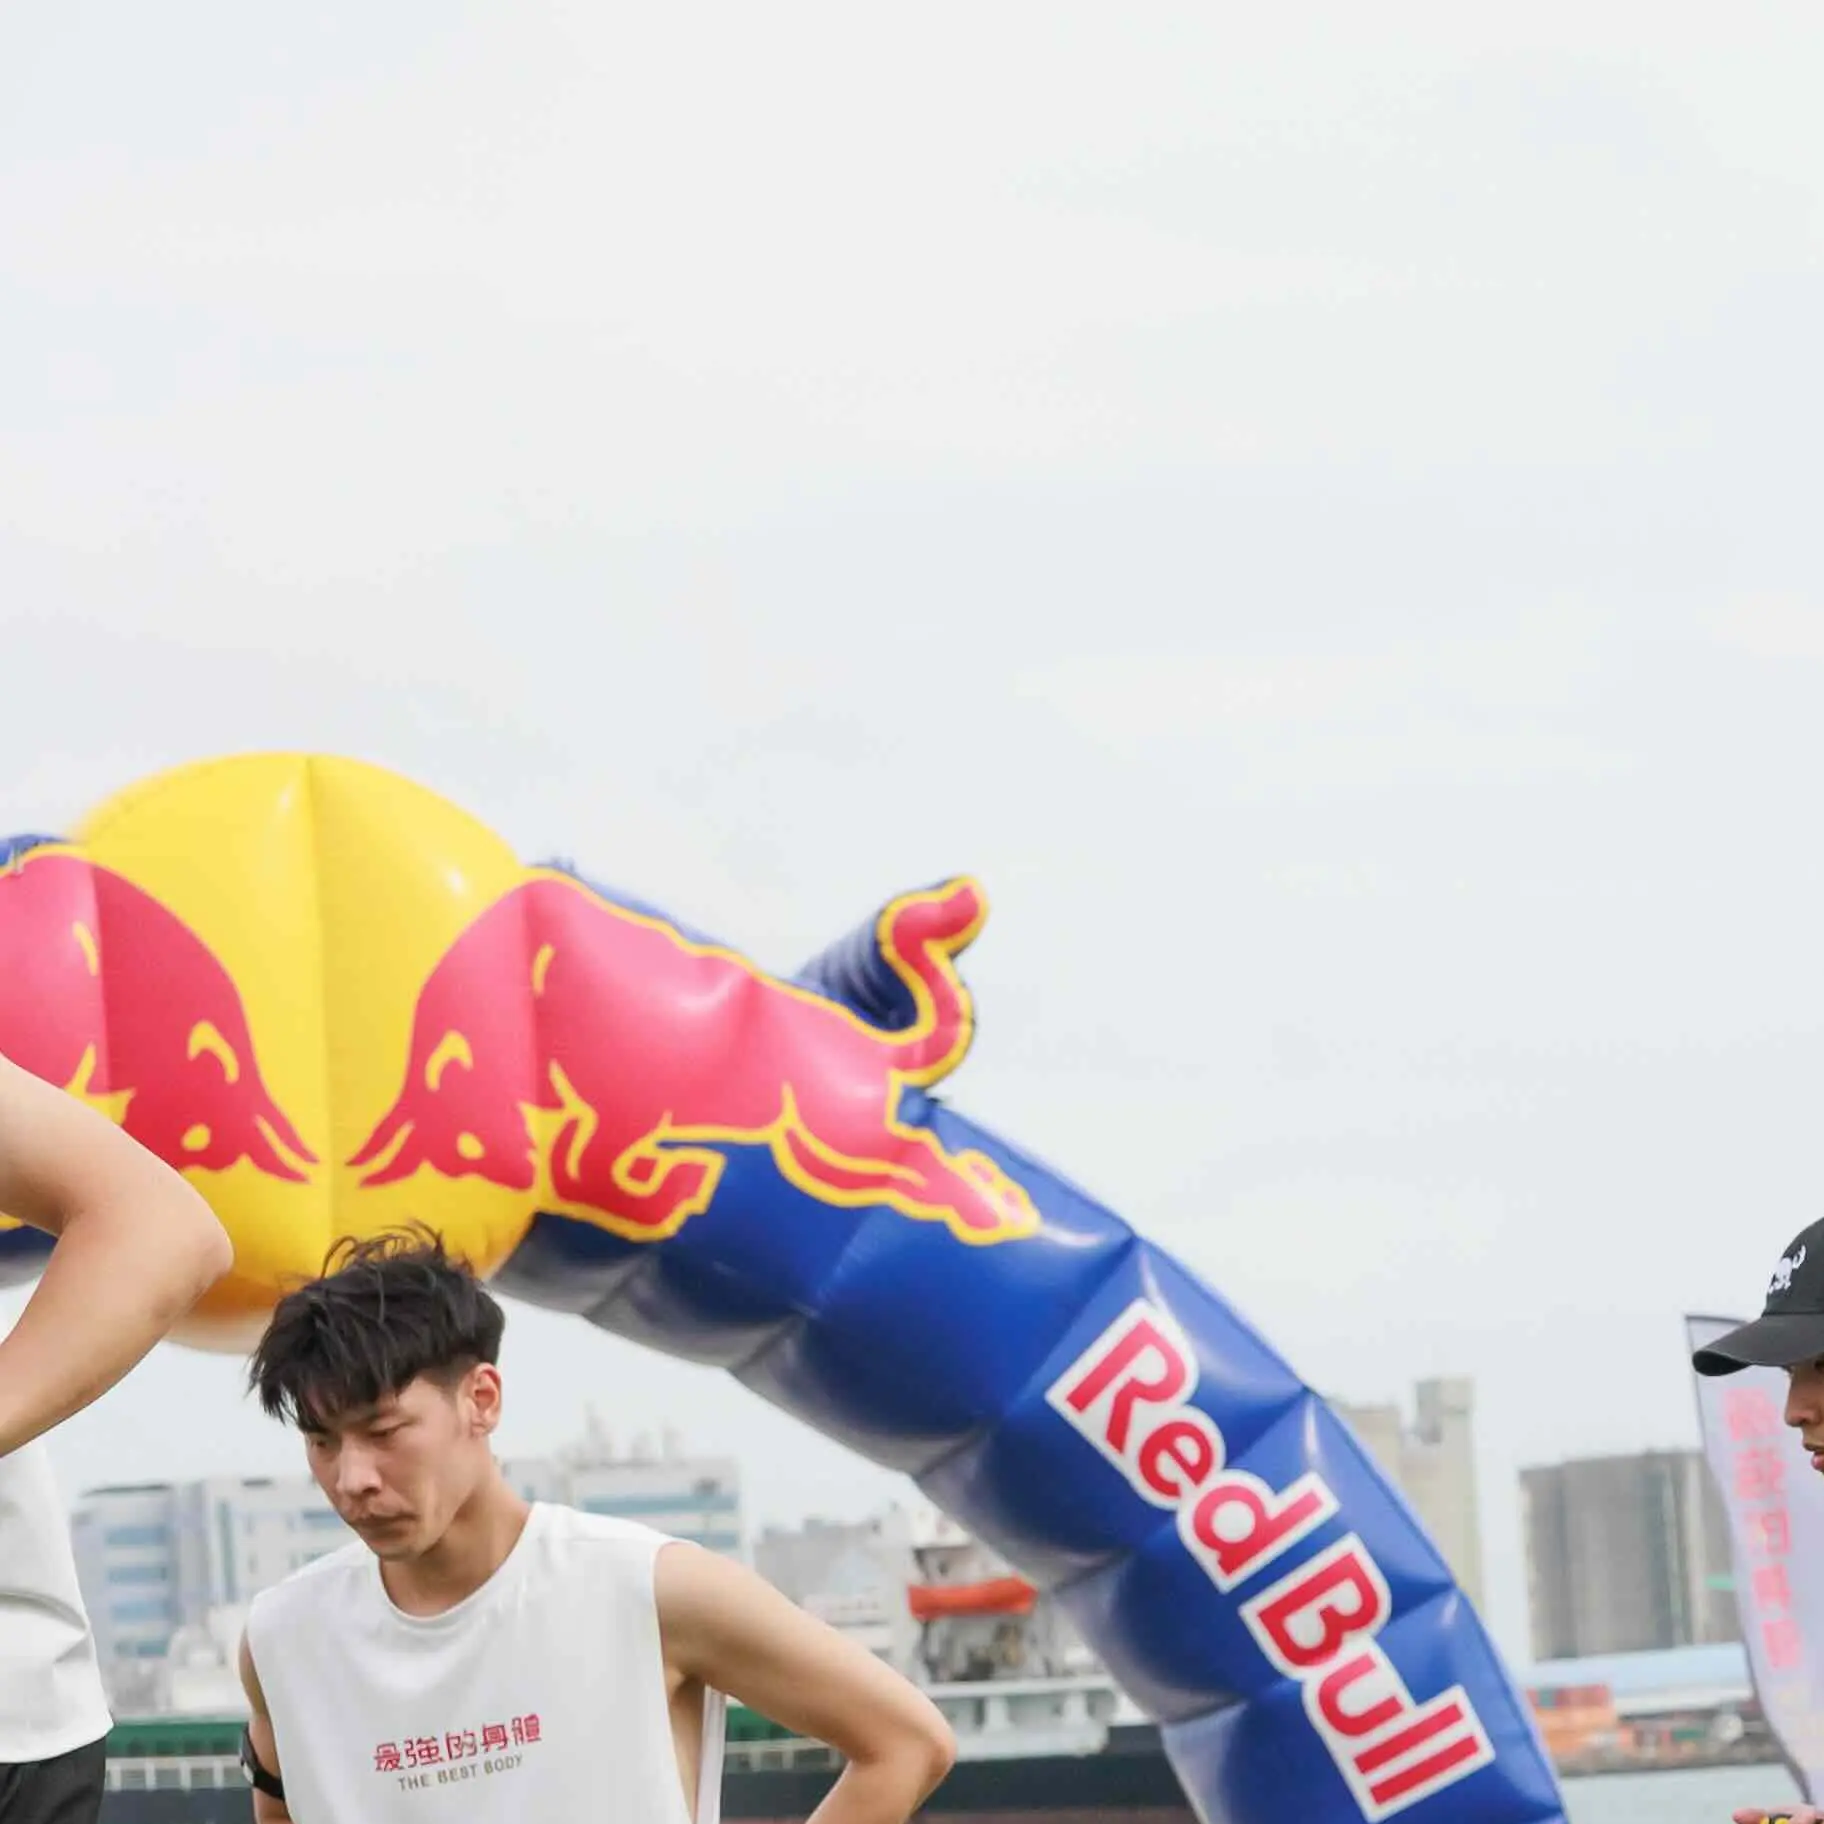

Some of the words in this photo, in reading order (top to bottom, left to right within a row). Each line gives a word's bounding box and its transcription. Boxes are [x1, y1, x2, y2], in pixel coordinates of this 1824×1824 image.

[1058, 1310, 1330, 1584] Red
[1252, 1547, 1485, 1810] Bull
[374, 1713, 542, 1773] 最強的身體
[398, 1774, 431, 1792] THE
[437, 1763, 479, 1785] BEST
[484, 1753, 524, 1775] BODY
